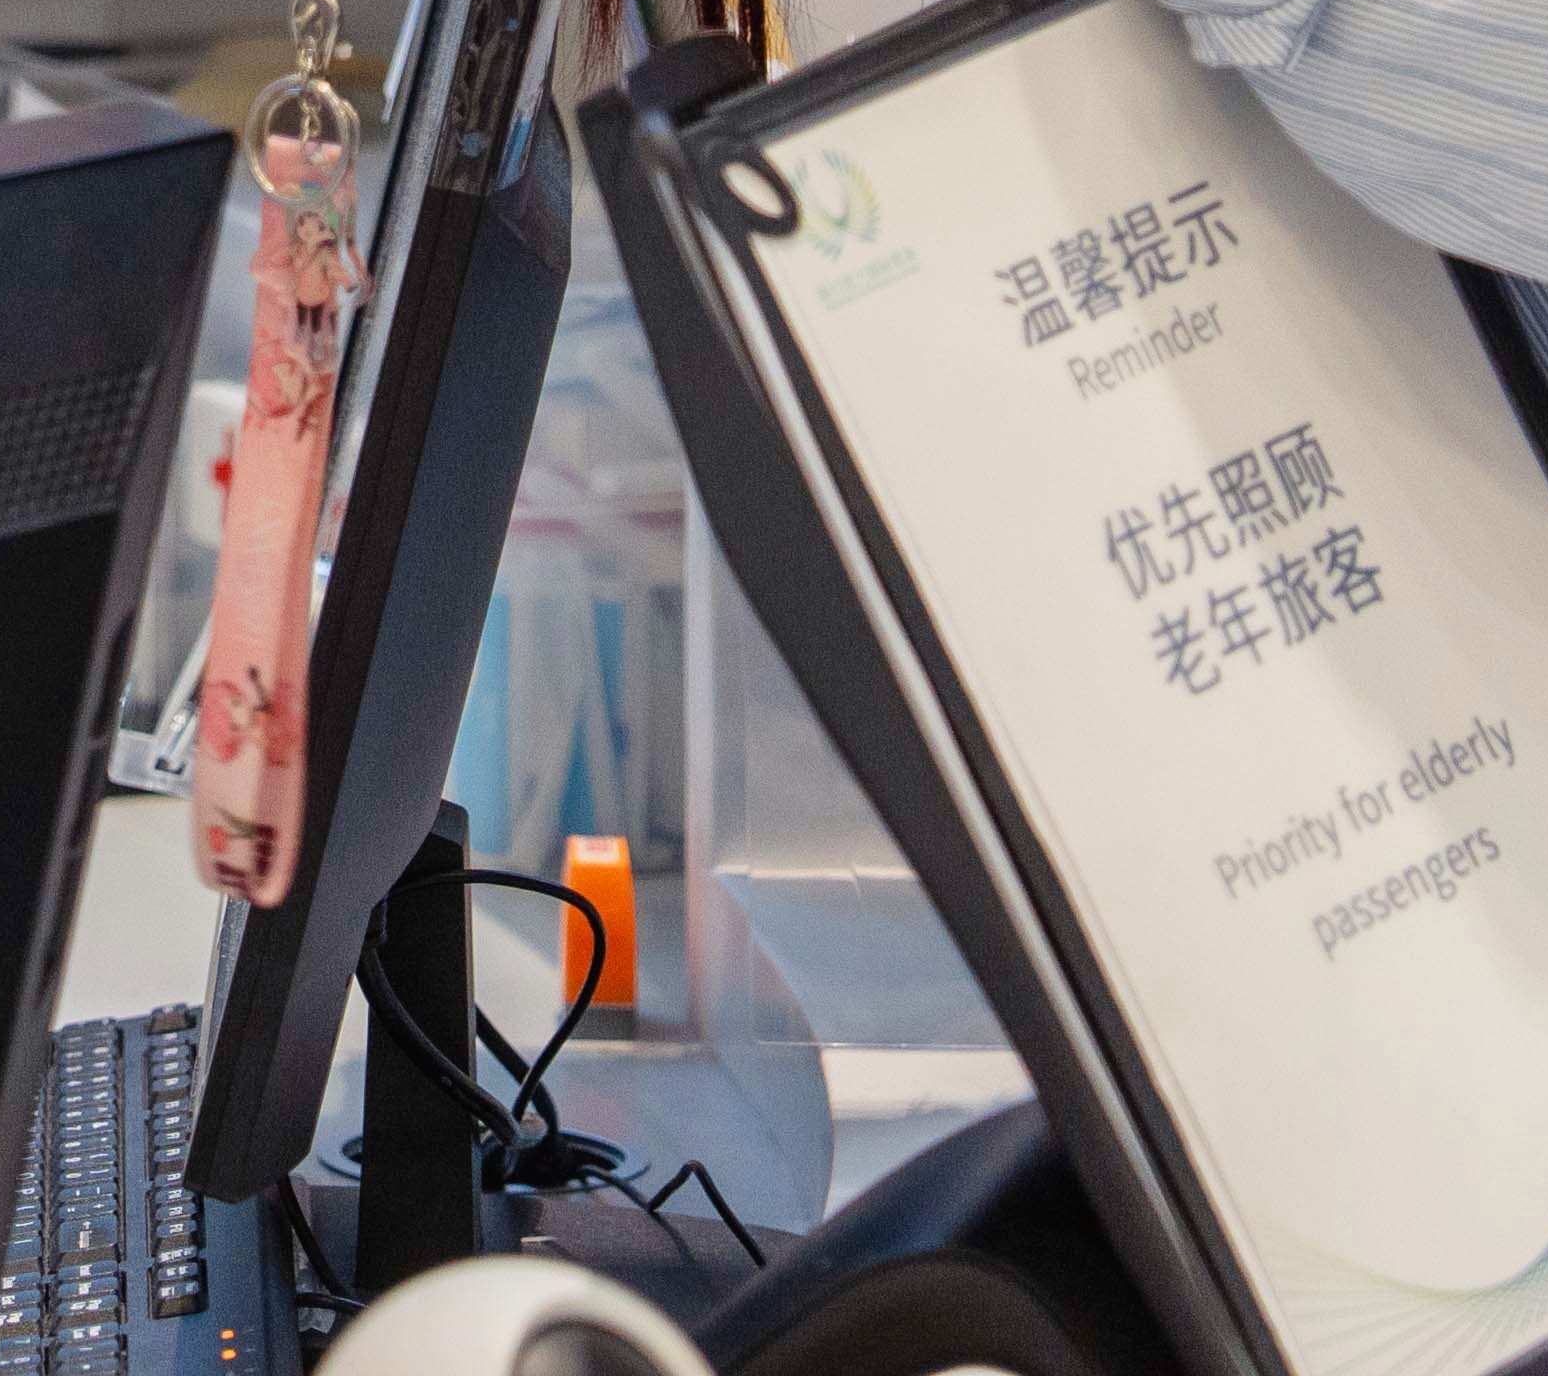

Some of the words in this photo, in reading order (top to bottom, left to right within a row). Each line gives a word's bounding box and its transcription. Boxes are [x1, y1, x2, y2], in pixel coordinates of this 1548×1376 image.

[993, 180, 1239, 347] 温馨提示
[1067, 301, 1224, 398] Reminder
[1103, 421, 1344, 600] 优先照顾
[1151, 523, 1384, 695] 老年旅客
[1214, 810, 1342, 900] Priority
[1337, 784, 1394, 833] for
[1399, 715, 1516, 802] elderly
[1311, 826, 1502, 963] passengers
